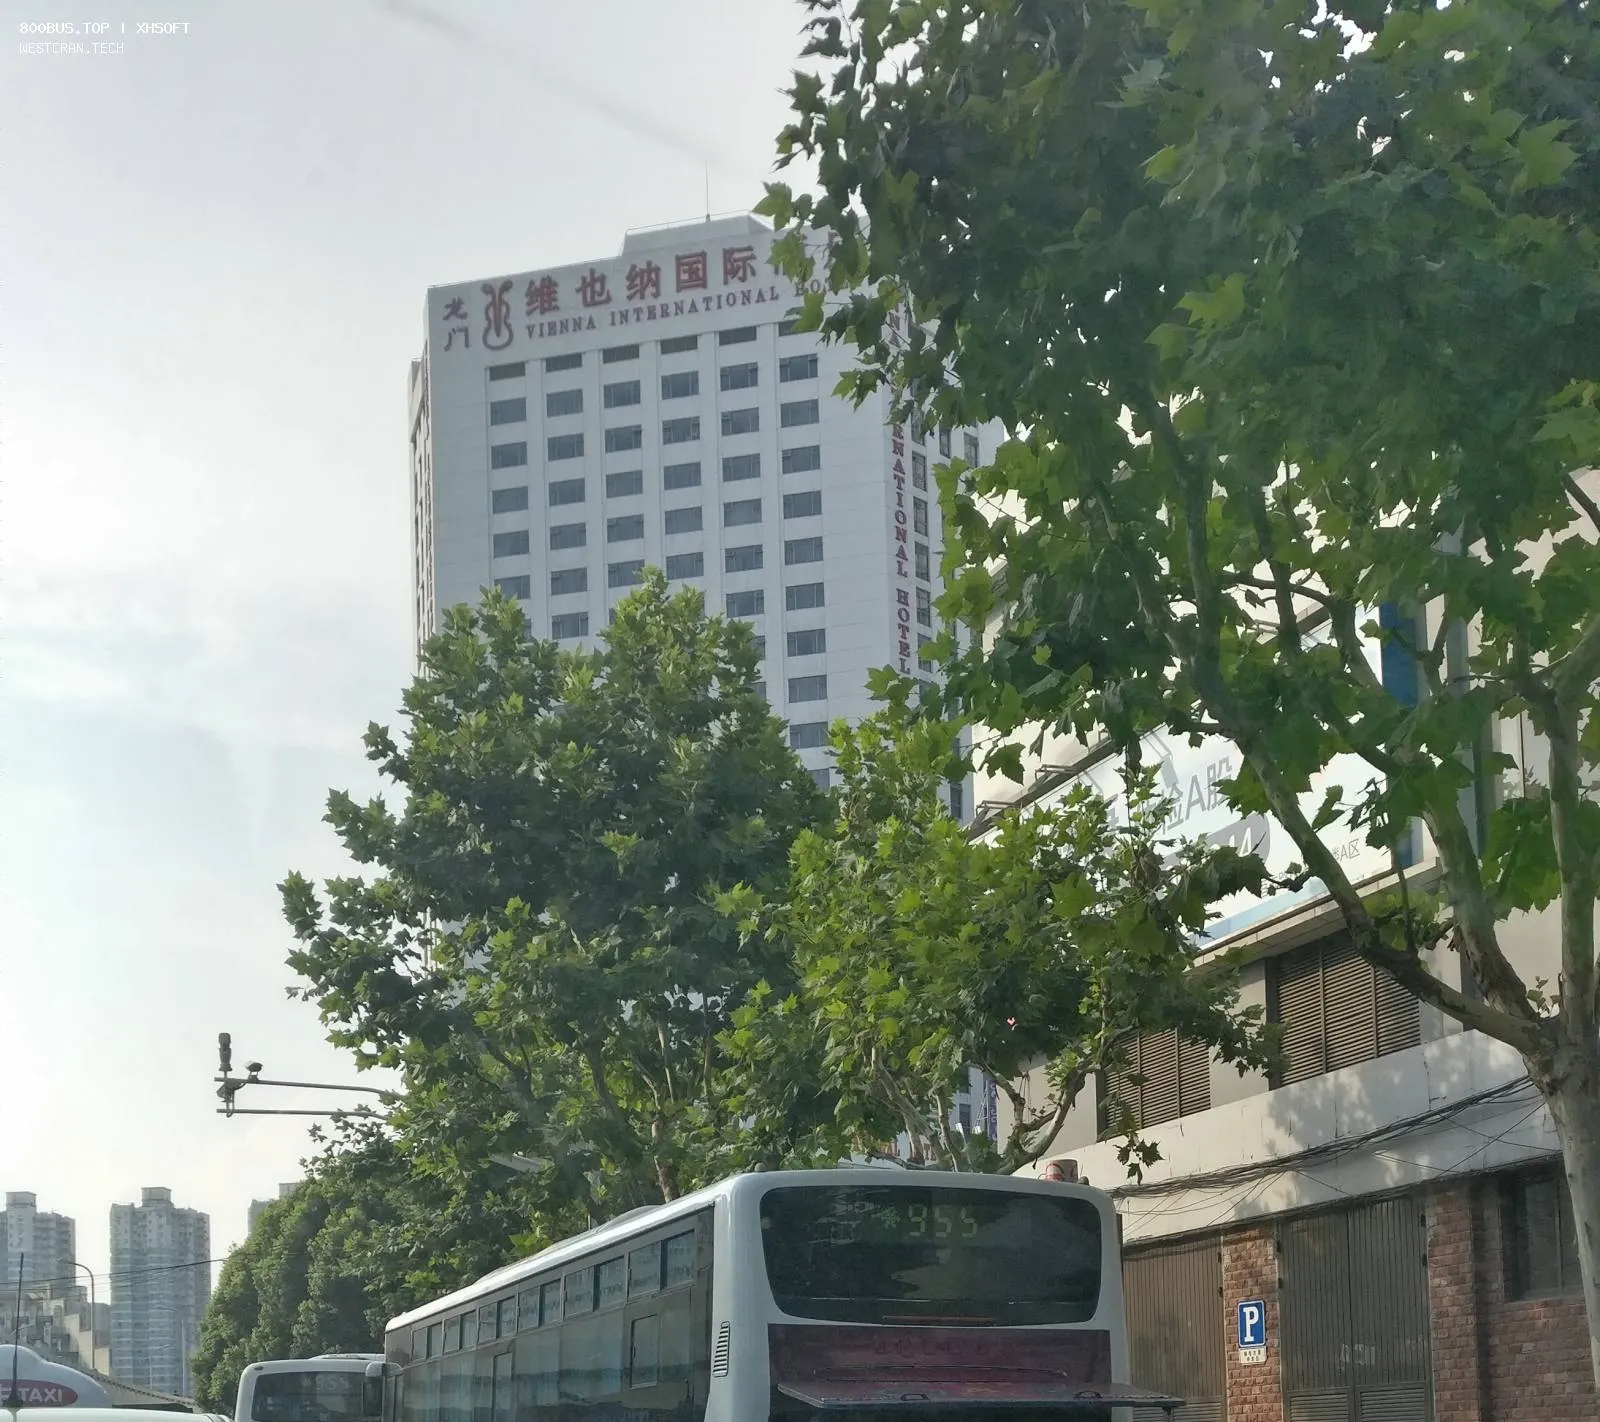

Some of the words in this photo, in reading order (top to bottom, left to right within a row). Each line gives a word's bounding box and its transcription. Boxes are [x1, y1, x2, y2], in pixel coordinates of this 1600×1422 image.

[525, 244, 786, 318] 维也纳国际
[526, 316, 597, 340] VIENNA
[609, 286, 780, 327] INTERNATIONAL
[896, 587, 911, 675] HOTEL
[908, 1204, 978, 1239] 955
[1243, 1306, 1259, 1342] P
[18, 1387, 63, 1402] TAXI
